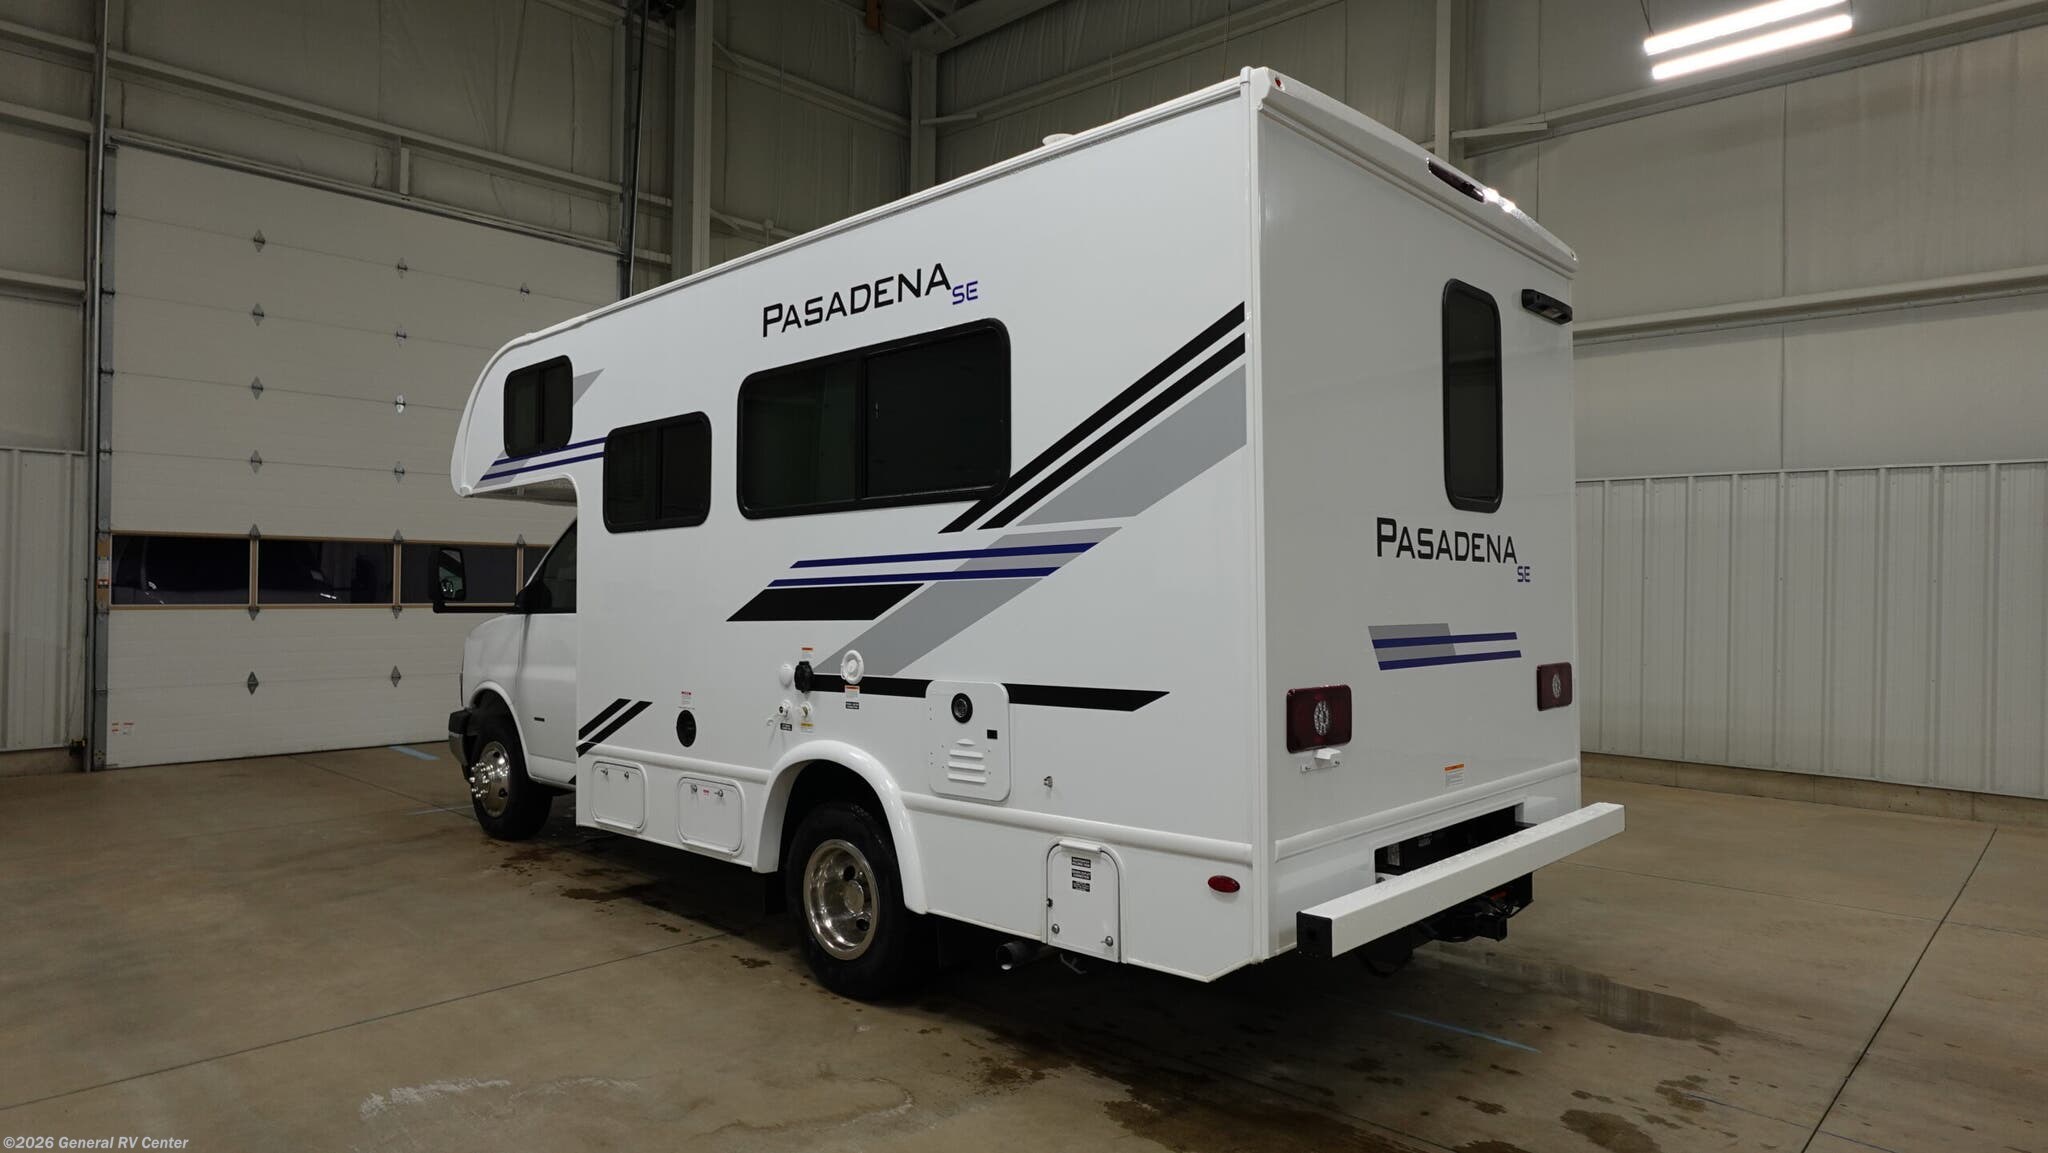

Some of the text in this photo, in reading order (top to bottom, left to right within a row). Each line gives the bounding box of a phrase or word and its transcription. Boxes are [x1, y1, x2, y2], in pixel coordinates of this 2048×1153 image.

[763, 263, 978, 338] PASADENA SE
[1377, 517, 1531, 582] PASADENA SE
